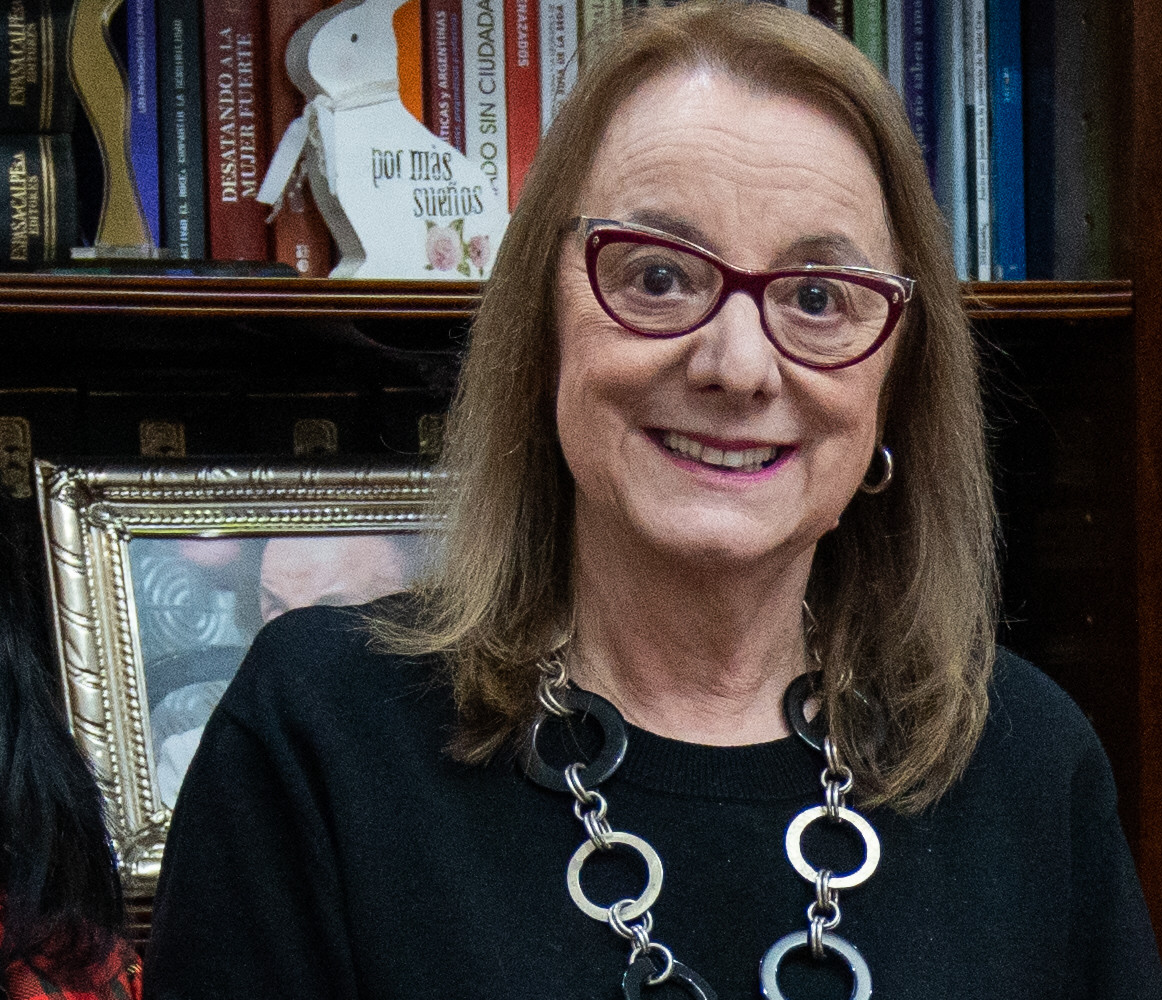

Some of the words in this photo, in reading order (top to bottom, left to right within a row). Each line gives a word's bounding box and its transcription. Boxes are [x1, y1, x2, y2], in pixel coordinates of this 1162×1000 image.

[219, 27, 233, 49] LA
[436, 10, 448, 88] ARGENTINAS
[219, 57, 233, 69] A
[236, 32, 255, 118] FUERTE
[478, 101, 497, 135] SIN
[914, 96, 924, 117] no
[217, 74, 238, 203] DESATANDO
[239, 125, 257, 198] MUJER
[371, 148, 404, 188] por
[28, 174, 39, 235] EDITORES
[413, 181, 484, 218] sueños
